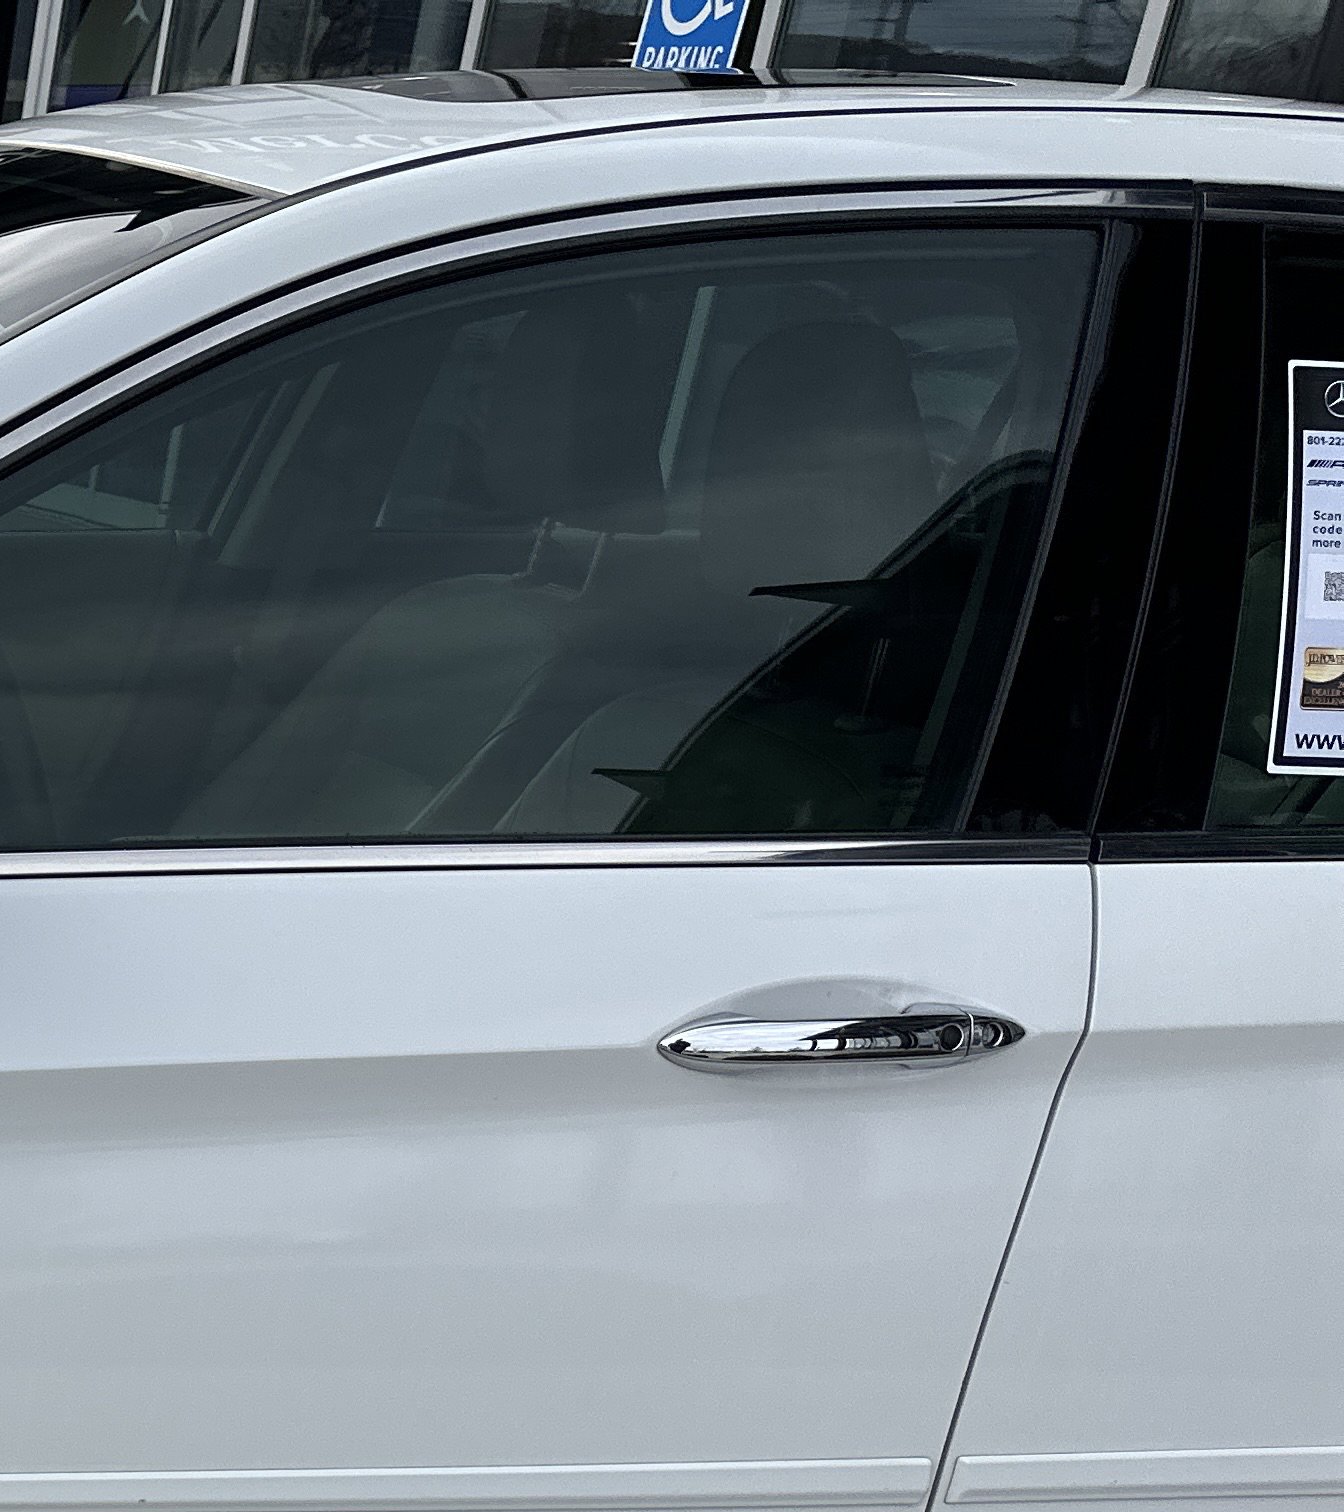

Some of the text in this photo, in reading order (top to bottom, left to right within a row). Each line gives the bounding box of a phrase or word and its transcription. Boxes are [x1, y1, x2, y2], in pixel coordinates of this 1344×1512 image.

[642, 46, 724, 69] PARKING
[1313, 510, 1341, 521] Scan
[1312, 525, 1343, 535] code
[1312, 539, 1341, 549] more
